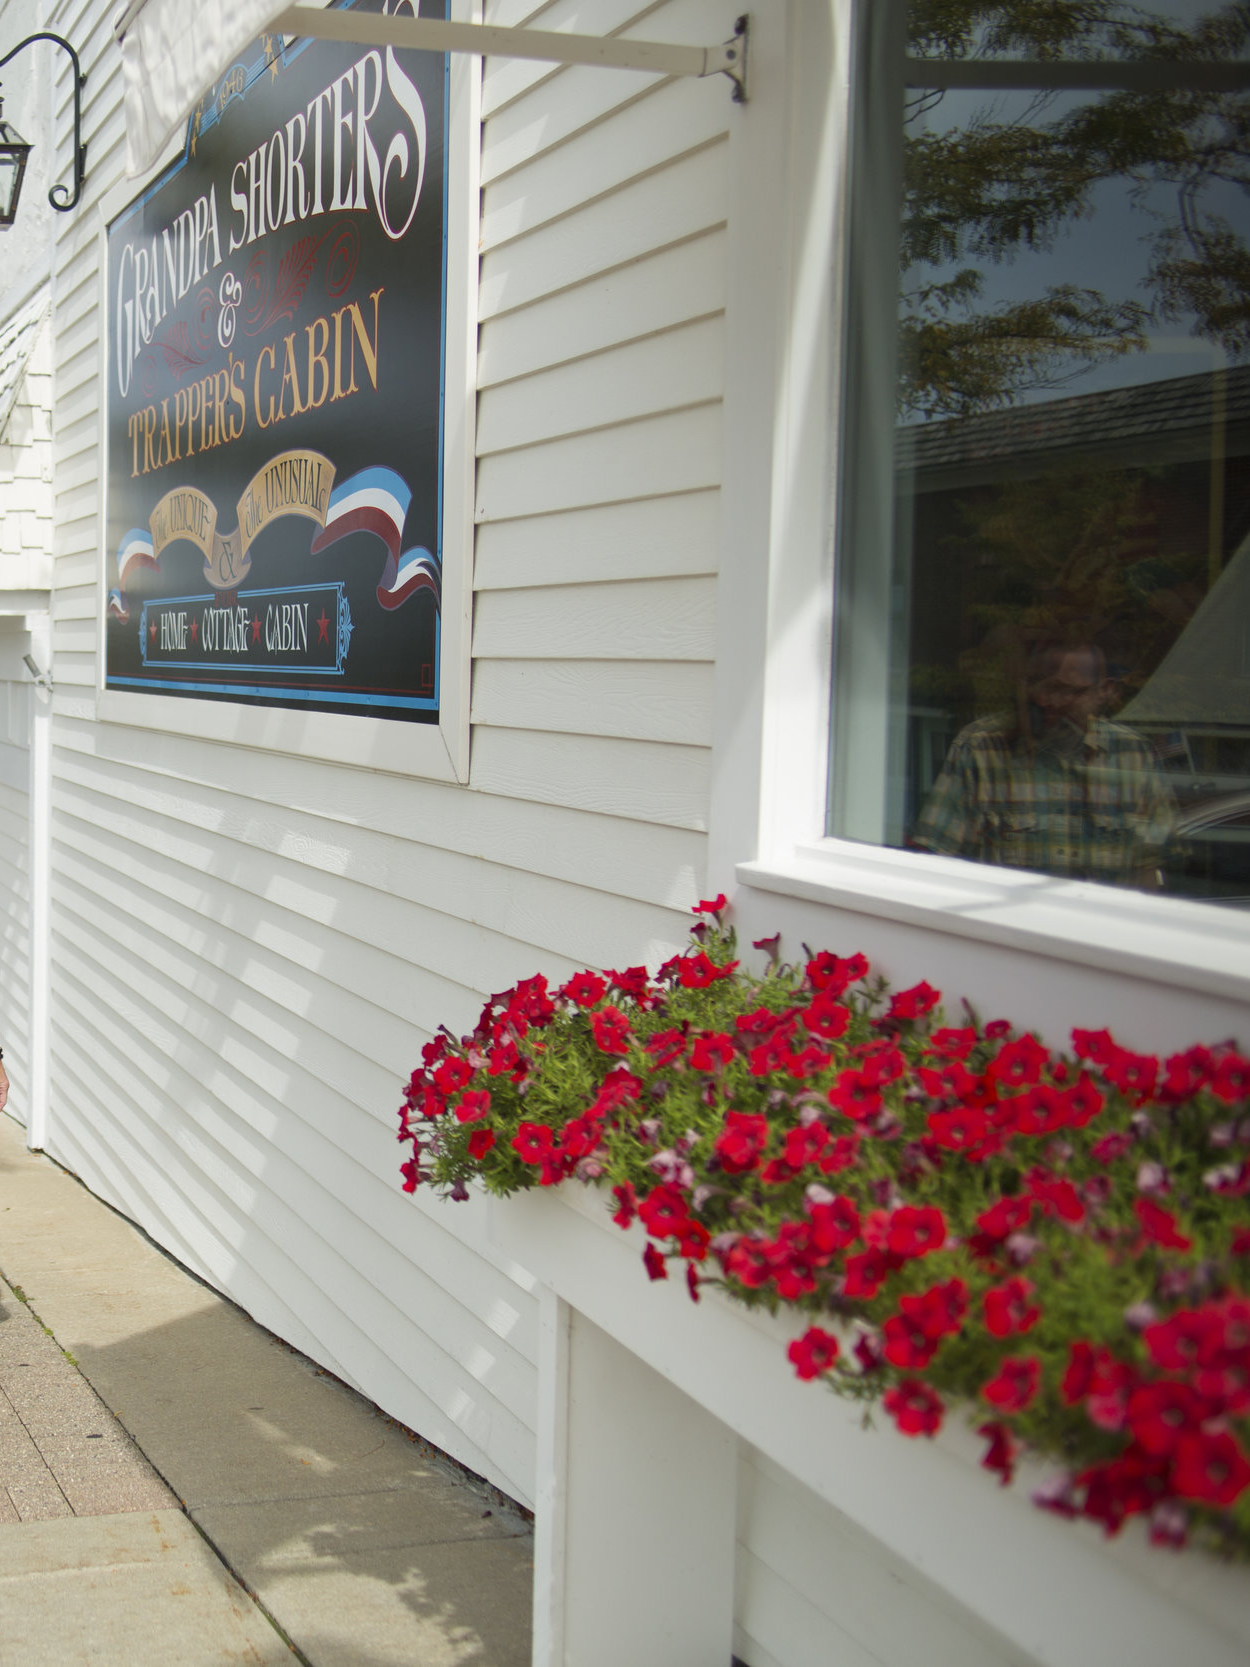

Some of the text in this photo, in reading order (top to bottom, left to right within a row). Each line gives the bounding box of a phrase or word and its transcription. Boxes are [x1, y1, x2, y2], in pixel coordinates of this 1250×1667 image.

[117, 181, 223, 398] GRANDPA
[218, 272, 242, 348] &
[128, 288, 384, 478] TRAPPER'S CABIN
[170, 494, 211, 541] UNIQUE
[219, 542, 237, 582] &
[265, 459, 326, 513] UNUSUAL
[161, 603, 309, 655] HOME COTTAGE CABIN
